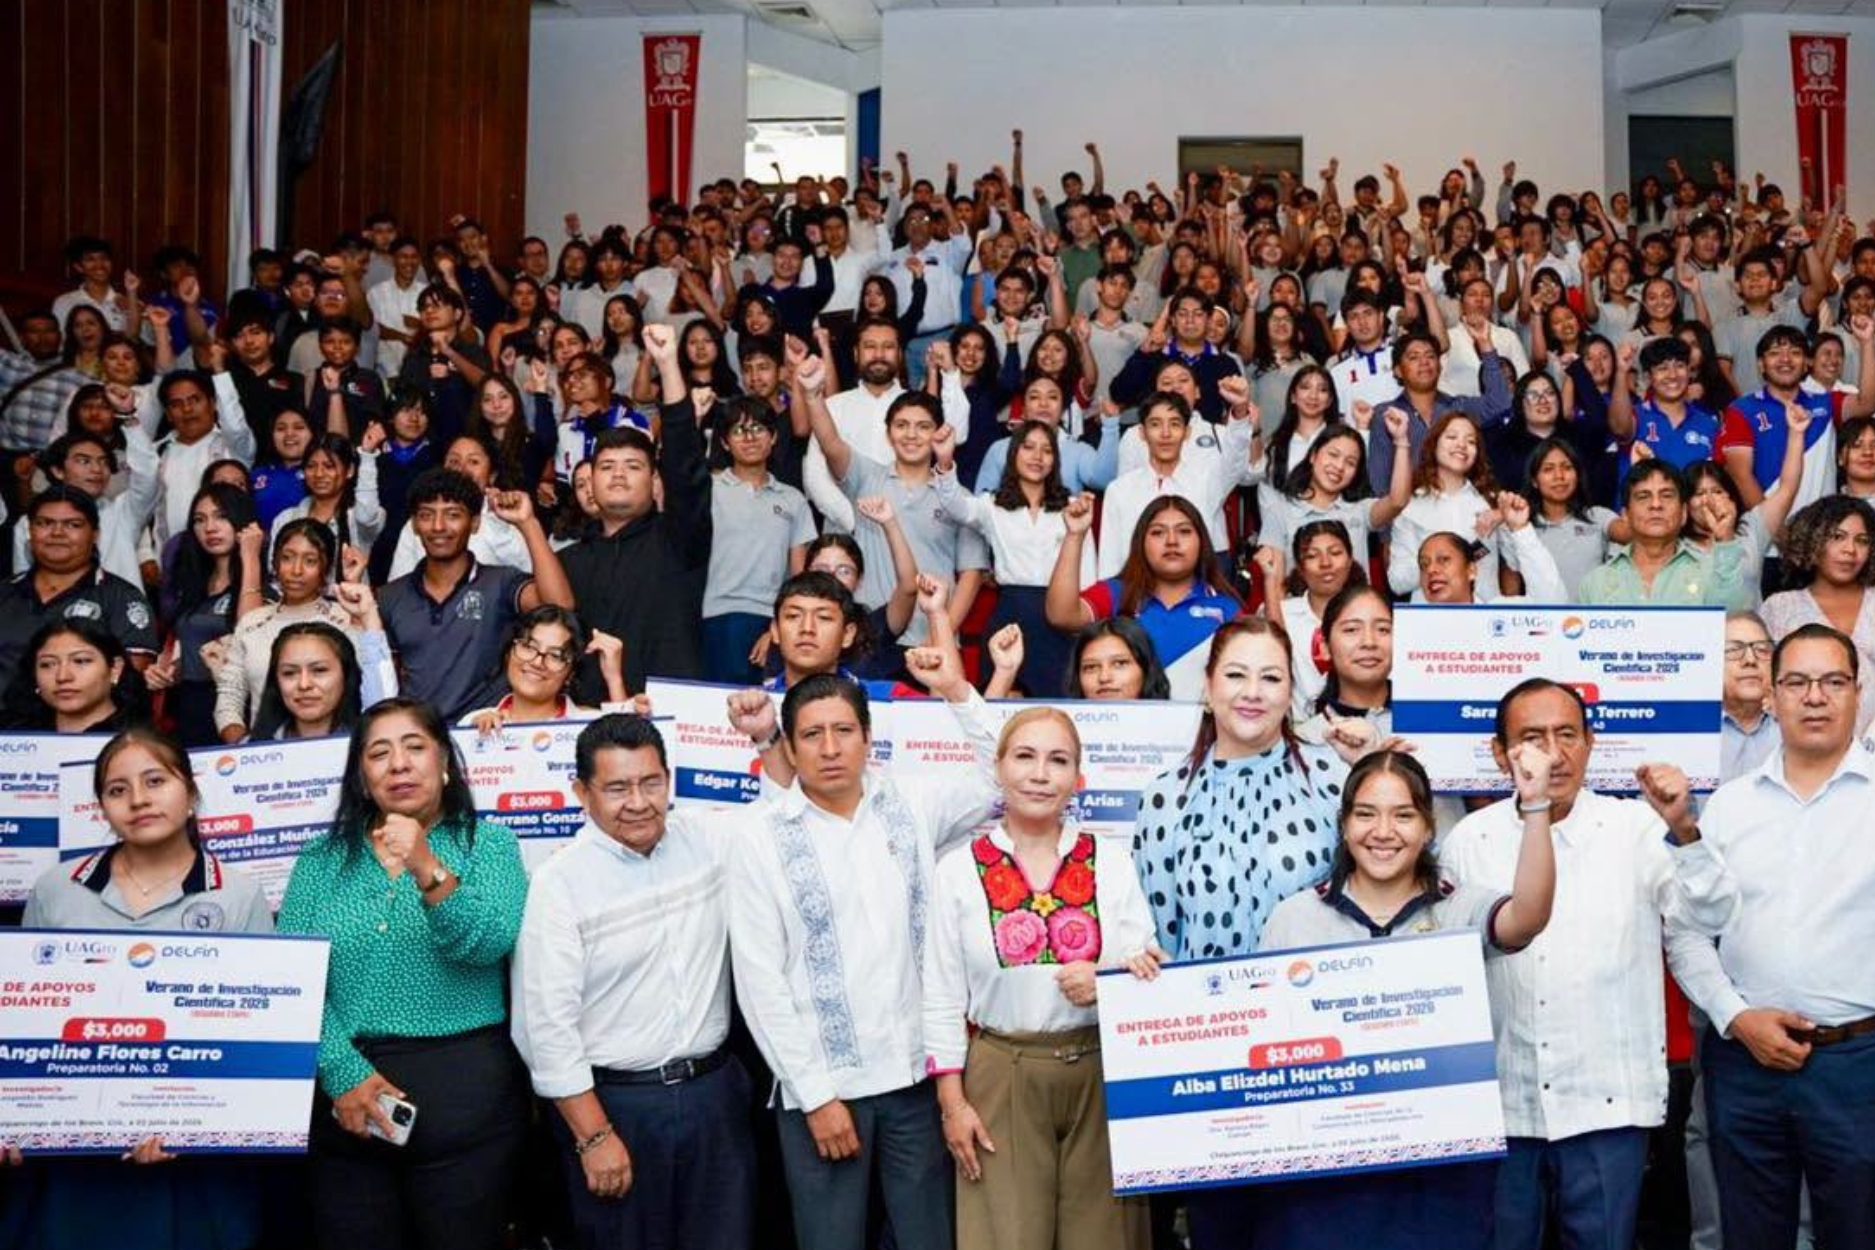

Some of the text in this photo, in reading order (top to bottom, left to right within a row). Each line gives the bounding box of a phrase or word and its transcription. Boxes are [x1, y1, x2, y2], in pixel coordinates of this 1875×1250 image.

[1596, 705, 1655, 718] Terrero
[694, 773, 737, 789] Edgar
[82, 1020, 147, 1039] $3,000
[1116, 1008, 1267, 1034] ENTREGA DE APOYOS
[1138, 1024, 1249, 1046] A ESTUDIANTES
[96, 1044, 162, 1060] Flores
[166, 1045, 222, 1061] Carro
[1266, 1043, 1324, 1064] $3,000
[46, 1062, 169, 1075] Preparatoria No. 02
[1172, 1056, 1426, 1096] Alba Elizdel Hurtado Mena
[1244, 1080, 1355, 1102] Preparatoria No. 33
